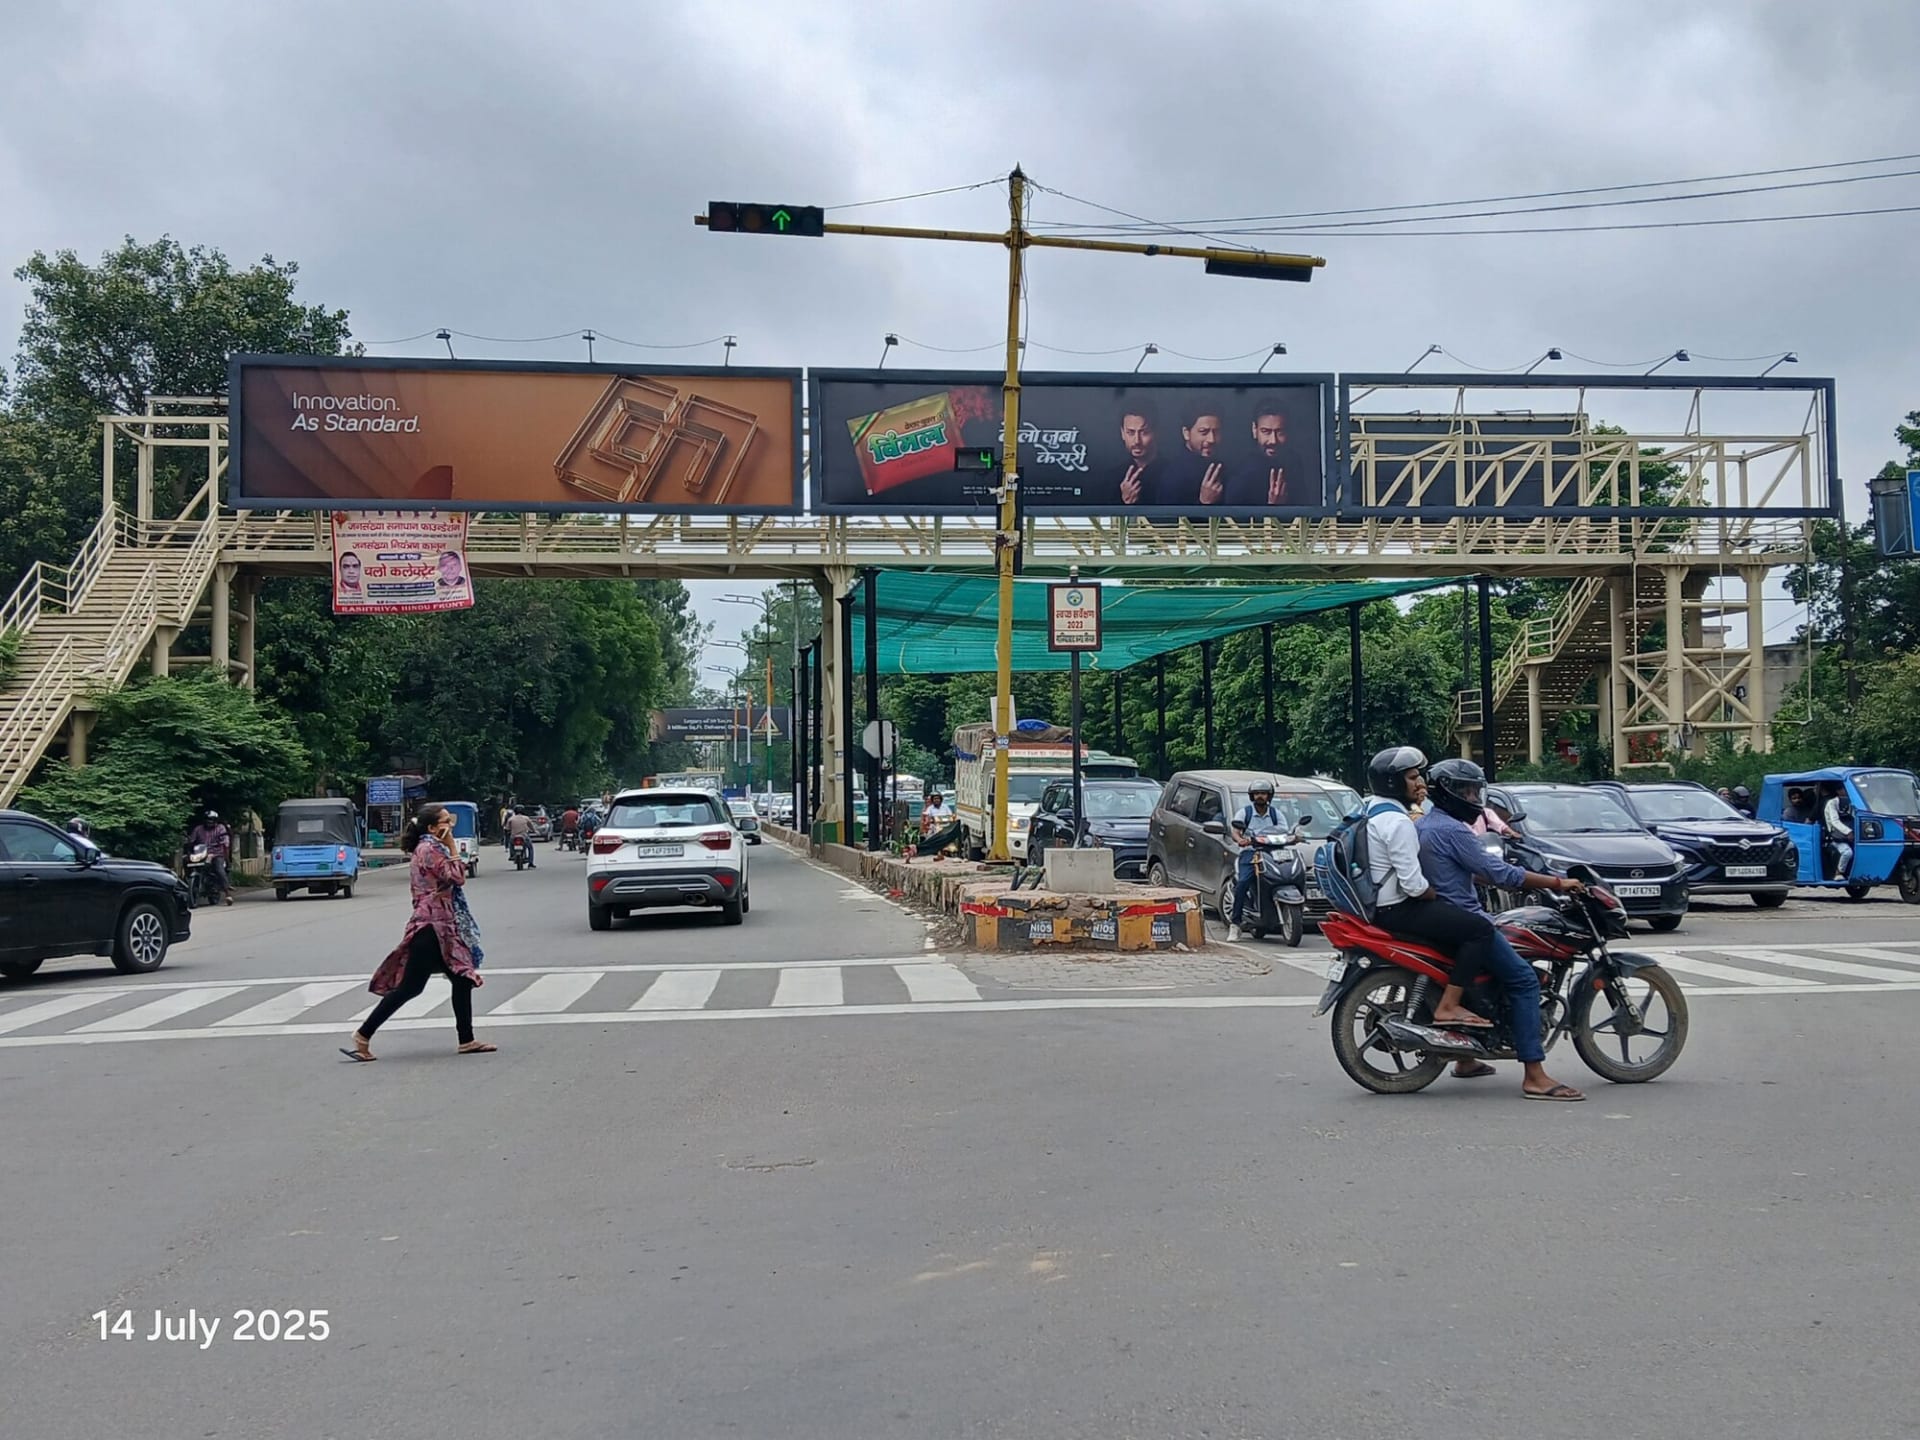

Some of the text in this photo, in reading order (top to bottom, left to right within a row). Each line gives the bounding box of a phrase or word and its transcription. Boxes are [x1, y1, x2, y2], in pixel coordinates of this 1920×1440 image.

[292, 392, 400, 411] Innovation.
[291, 413, 420, 433] As Standard.
[1042, 427, 1079, 449] जुबां
[980, 451, 991, 469] 4
[1034, 444, 1089, 471] केसरी
[364, 563, 387, 577] चलो
[433, 601, 465, 609] FRONT
[1067, 621, 1083, 629] 2023
[1030, 923, 1052, 933] NIOS
[1093, 923, 1115, 934] NIOS
[1152, 926, 1170, 935] NIOS
